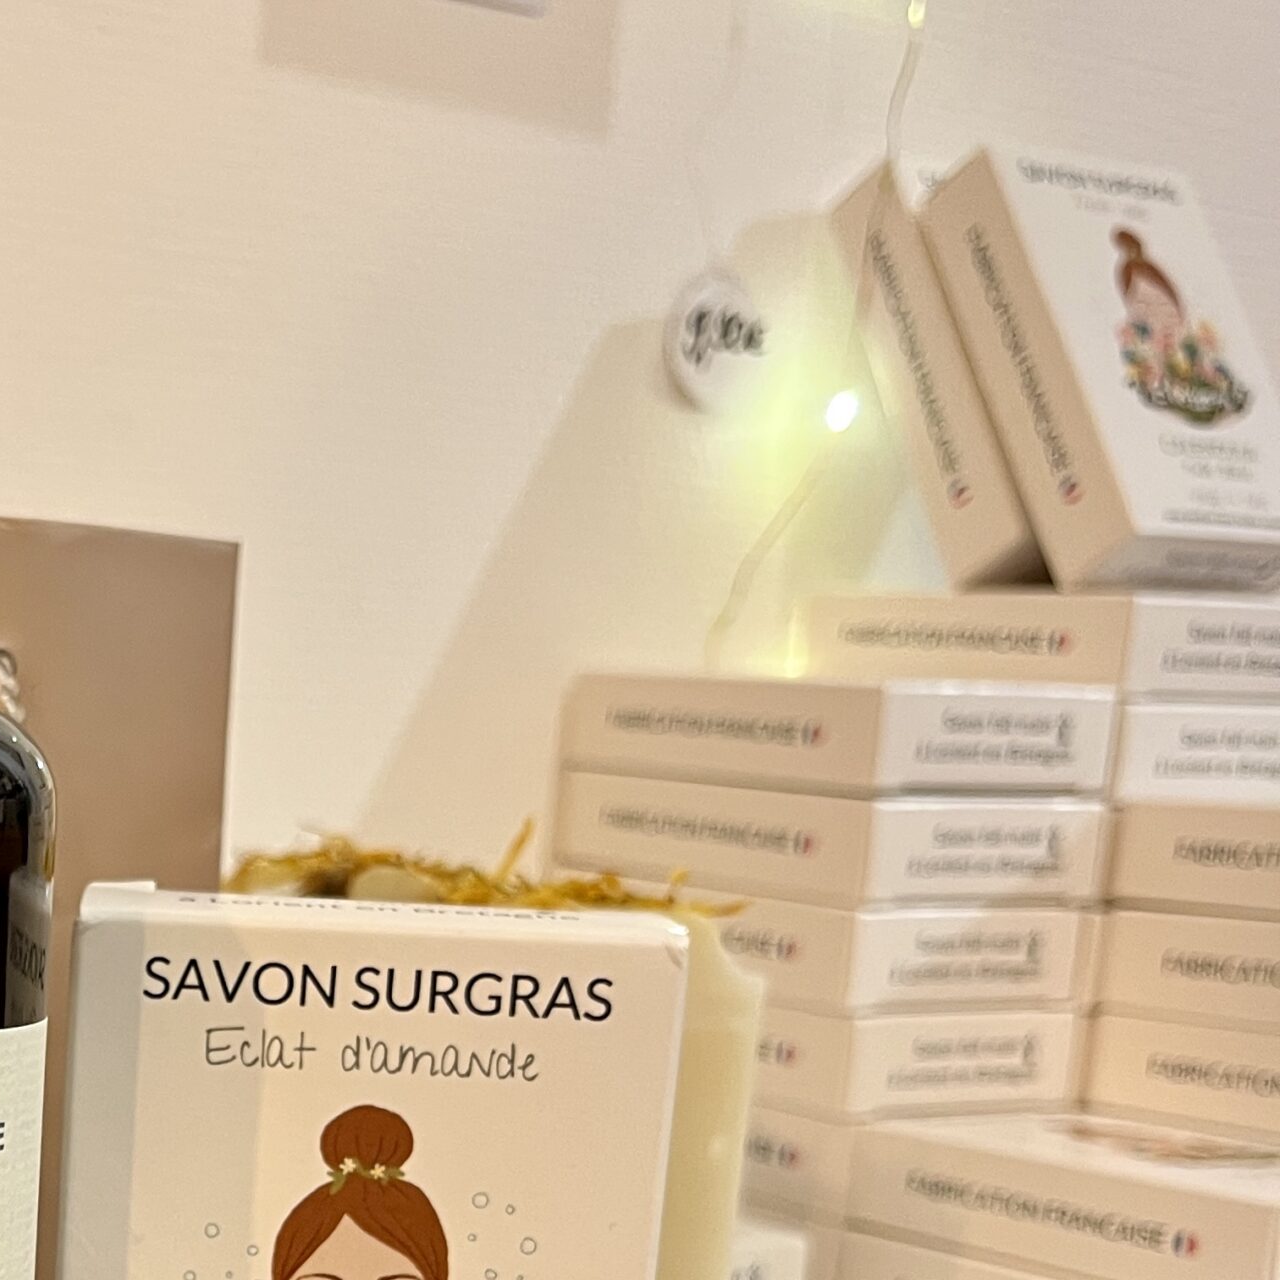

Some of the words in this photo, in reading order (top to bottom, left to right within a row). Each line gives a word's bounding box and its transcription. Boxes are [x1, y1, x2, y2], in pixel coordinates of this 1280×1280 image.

[143, 956, 337, 1008] SAVON
[352, 967, 614, 1022] SURGRAS
[205, 1026, 317, 1070] Eclat
[341, 1035, 539, 1082] d'amande
